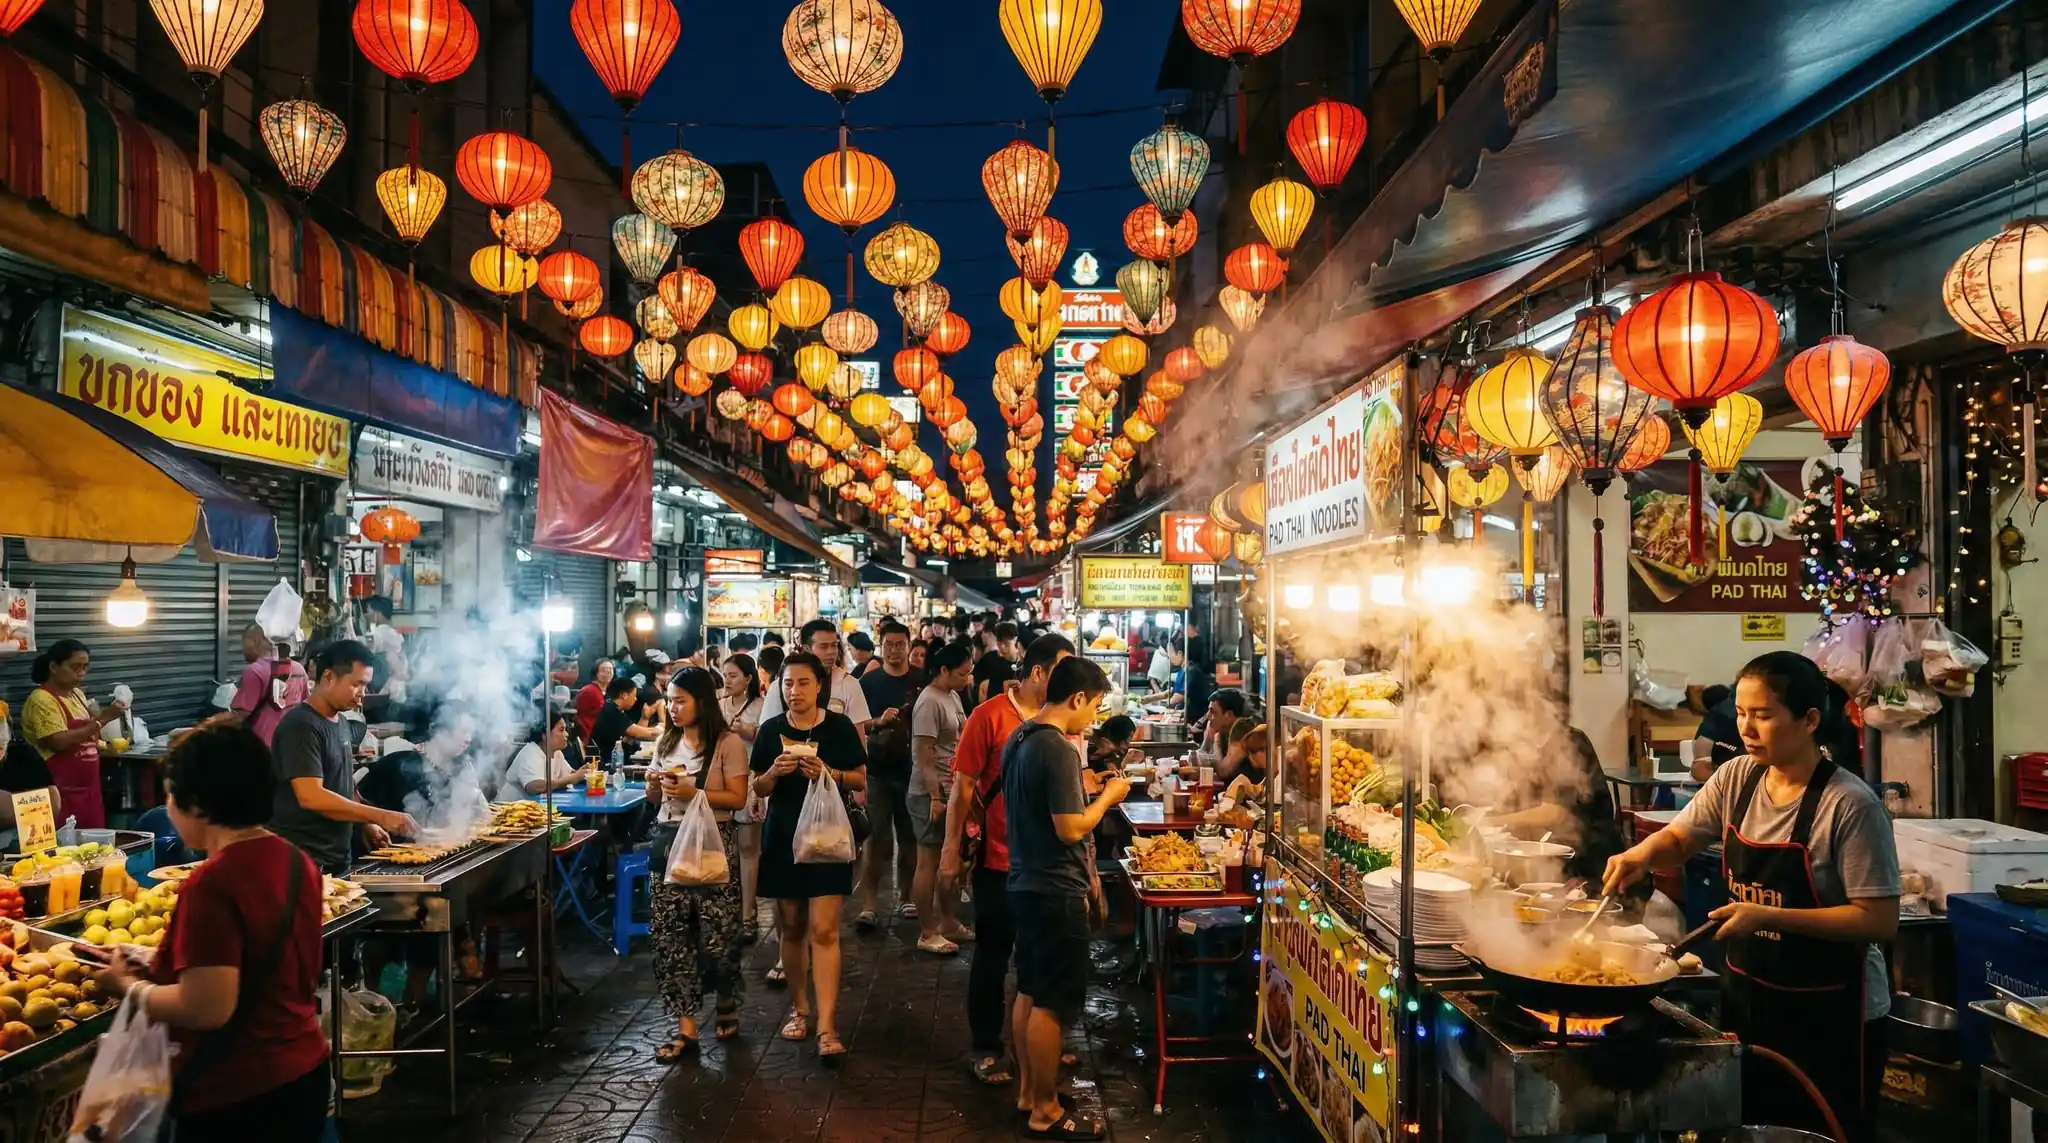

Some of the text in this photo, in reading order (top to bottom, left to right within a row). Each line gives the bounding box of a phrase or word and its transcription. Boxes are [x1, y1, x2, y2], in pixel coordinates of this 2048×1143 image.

[1269, 497, 1359, 548] PAD THAI NOODLES
[1711, 584, 1787, 599] PAD THAI
[1305, 995, 1367, 1096] PAD THAI
